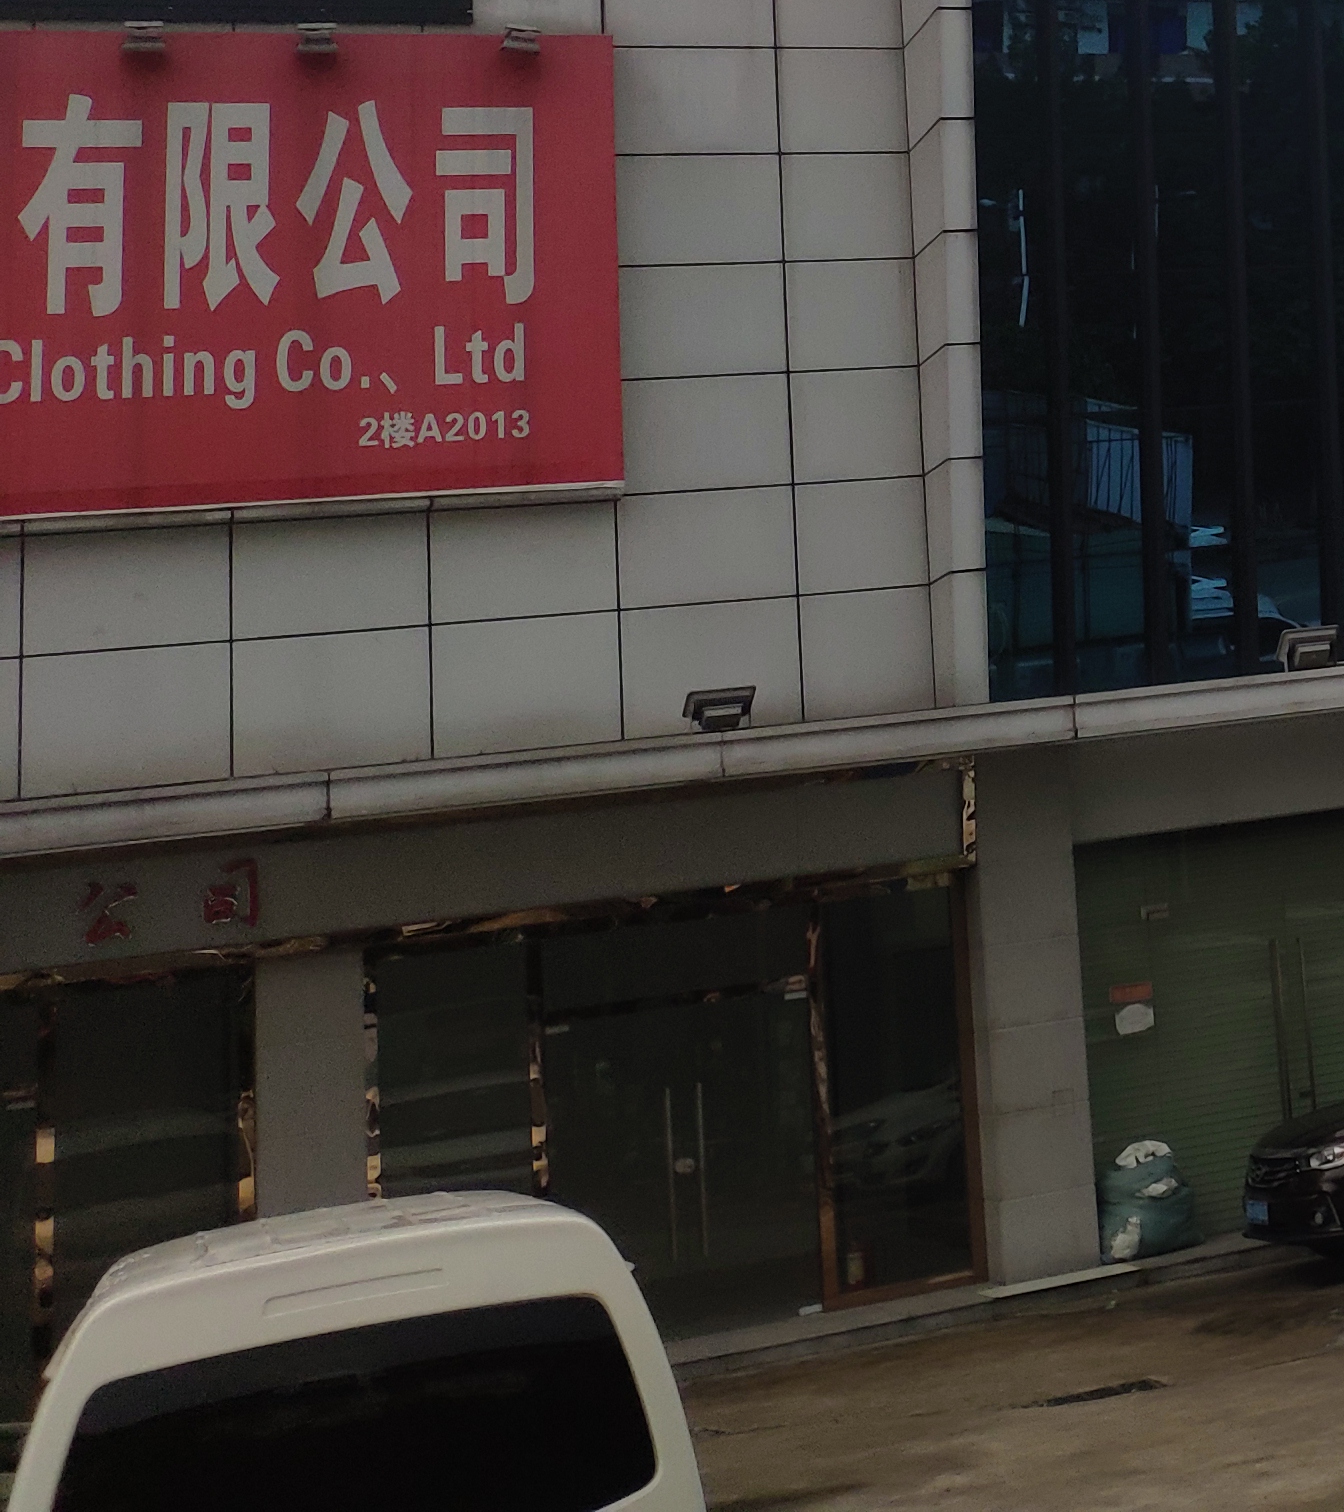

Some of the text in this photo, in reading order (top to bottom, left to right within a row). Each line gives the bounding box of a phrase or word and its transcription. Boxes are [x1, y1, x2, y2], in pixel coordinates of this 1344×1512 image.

[17, 94, 537, 317] 有限公司
[0, 336, 257, 410] Clothing
[434, 322, 527, 386] Ltd
[358, 410, 531, 449] 2楼A2013
